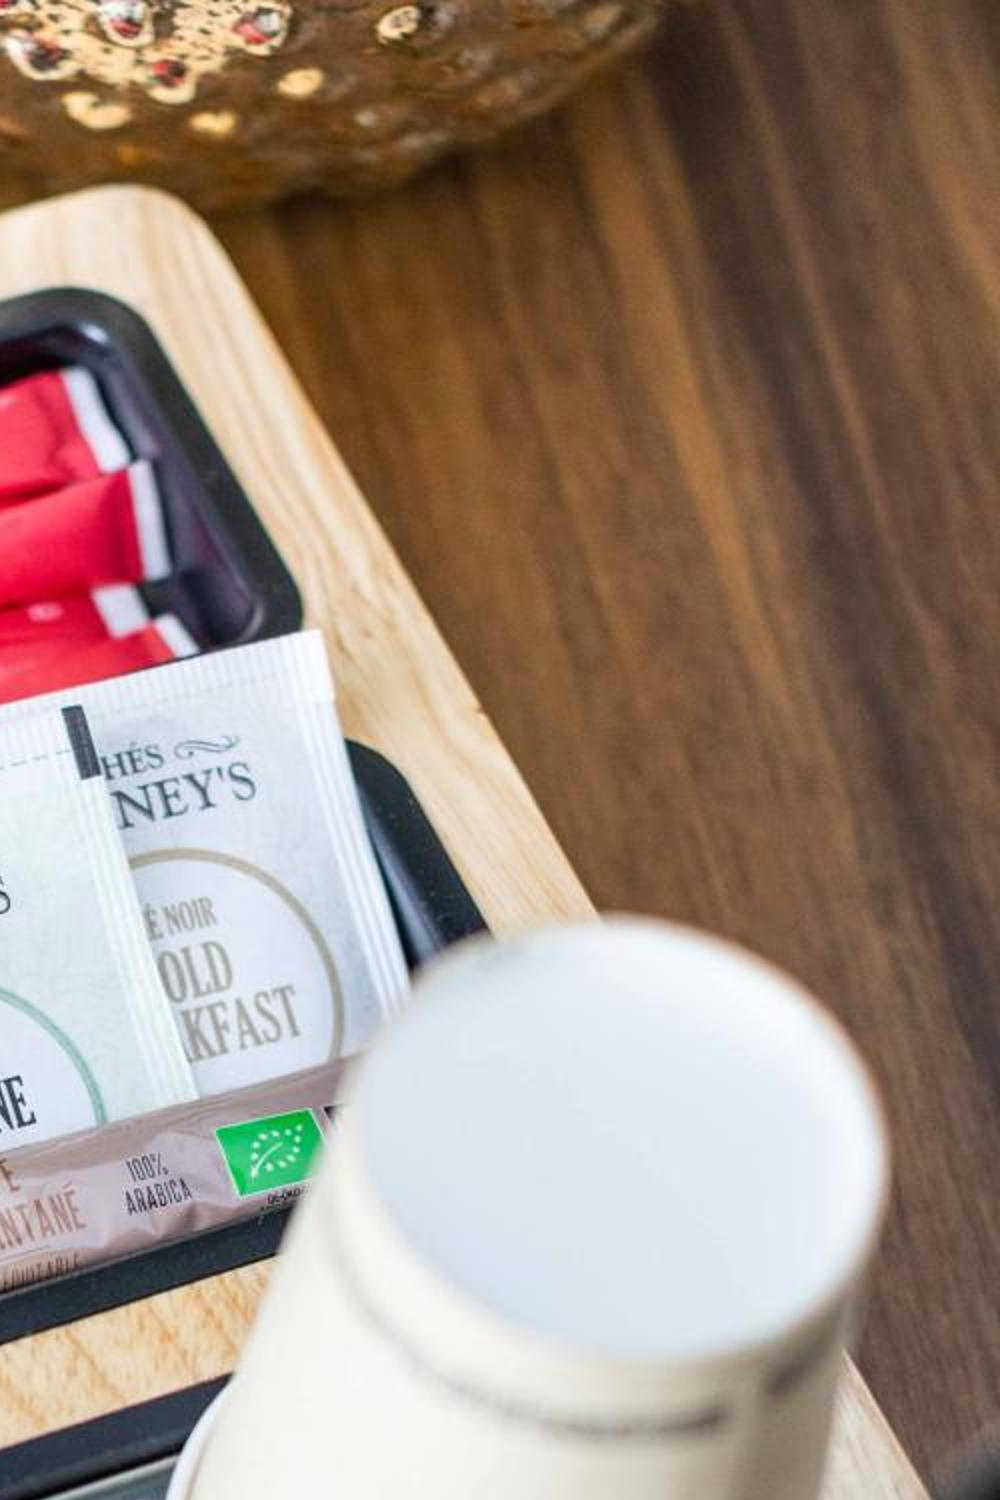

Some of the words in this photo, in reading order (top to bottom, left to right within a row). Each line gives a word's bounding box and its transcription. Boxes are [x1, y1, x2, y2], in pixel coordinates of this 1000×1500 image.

[101, 741, 165, 781] HÉS
[110, 761, 257, 830] NEY'S
[164, 896, 218, 937] NOIR
[157, 941, 234, 1004] OLD
[182, 985, 302, 1065] KFAST
[127, 1152, 169, 1182] 100%
[125, 1178, 194, 1216] ARABICA
